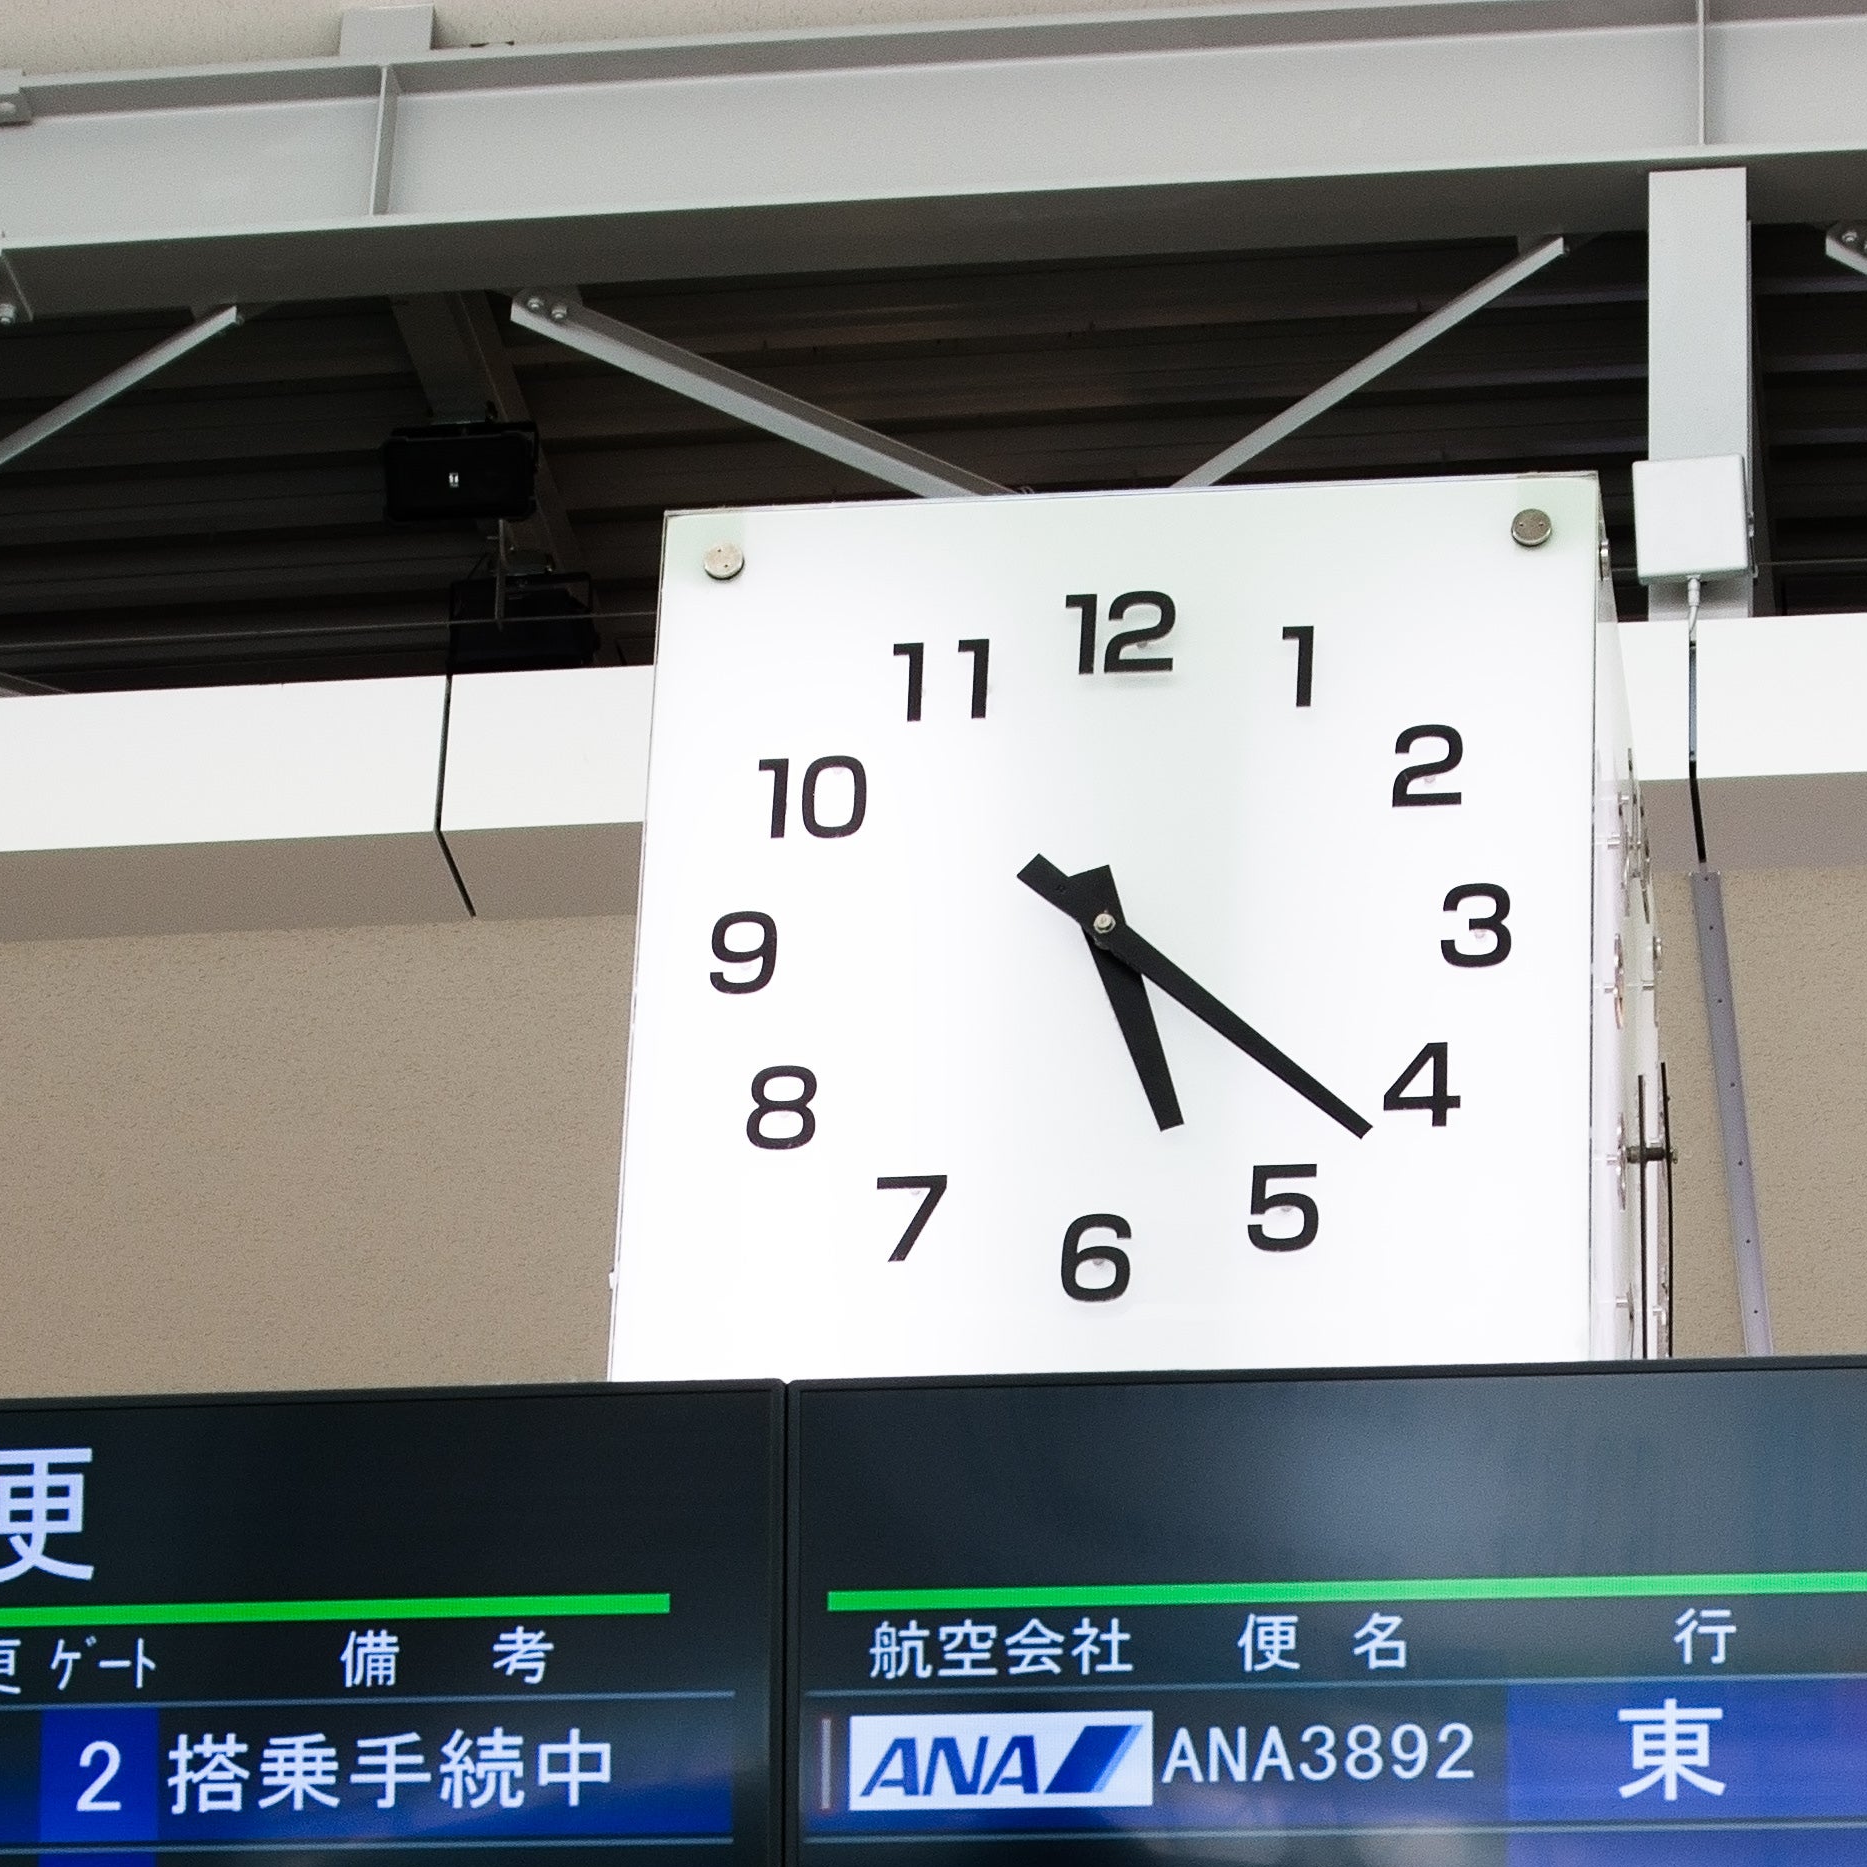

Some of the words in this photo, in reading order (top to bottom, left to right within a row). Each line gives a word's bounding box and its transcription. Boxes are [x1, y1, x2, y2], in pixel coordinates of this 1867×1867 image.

[1065, 590, 1176, 675] 12
[1282, 625, 1315, 708] 1
[892, 638, 990, 722] 11
[758, 755, 867, 839] 10
[1391, 724, 1464, 808] 2
[709, 910, 778, 995] 9
[1440, 882, 1512, 968] 3
[746, 1065, 818, 1150] 8
[1383, 1041, 1461, 1127] 4
[876, 1174, 948, 1262] 7
[1247, 1163, 1319, 1253] 5
[1060, 1213, 1132, 1303] 6
[340, 1625, 554, 1688] 備考
[869, 1617, 1133, 1680] 航空会社
[1237, 1612, 1407, 1672] 便名
[76, 1740, 121, 1812] 2
[167, 1727, 611, 1815] 搭乗手続中
[860, 1735, 1041, 1797] ANA
[1161, 1722, 1474, 1784] ANA3892
